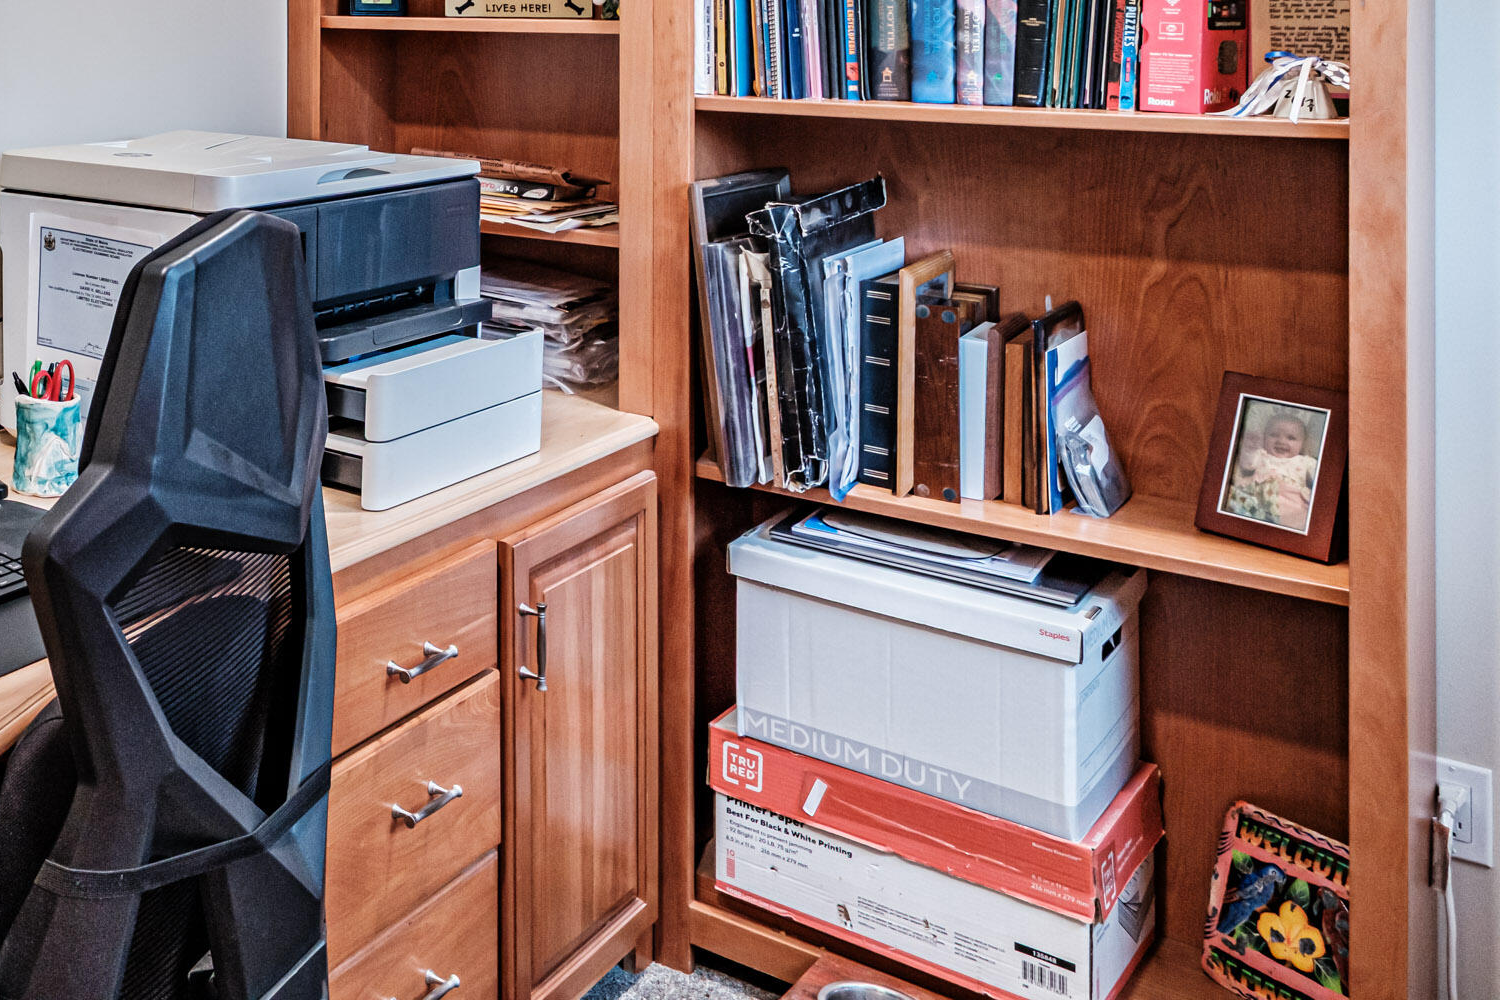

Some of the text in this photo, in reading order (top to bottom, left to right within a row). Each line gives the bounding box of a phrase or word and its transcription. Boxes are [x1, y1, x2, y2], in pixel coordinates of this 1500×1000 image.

[486, 3, 551, 12] LIVES HERE!
[1124, 6, 1137, 47] PUZZLES
[886, 7, 895, 50] POTTER
[1039, 629, 1070, 642] Staples
[730, 752, 756, 769] TRU
[730, 764, 757, 780] RED
[745, 713, 971, 800] MEDIUM DUTY
[726, 807, 853, 858] Best For Black & White Printing
[1240, 821, 1349, 891] WELCOM
